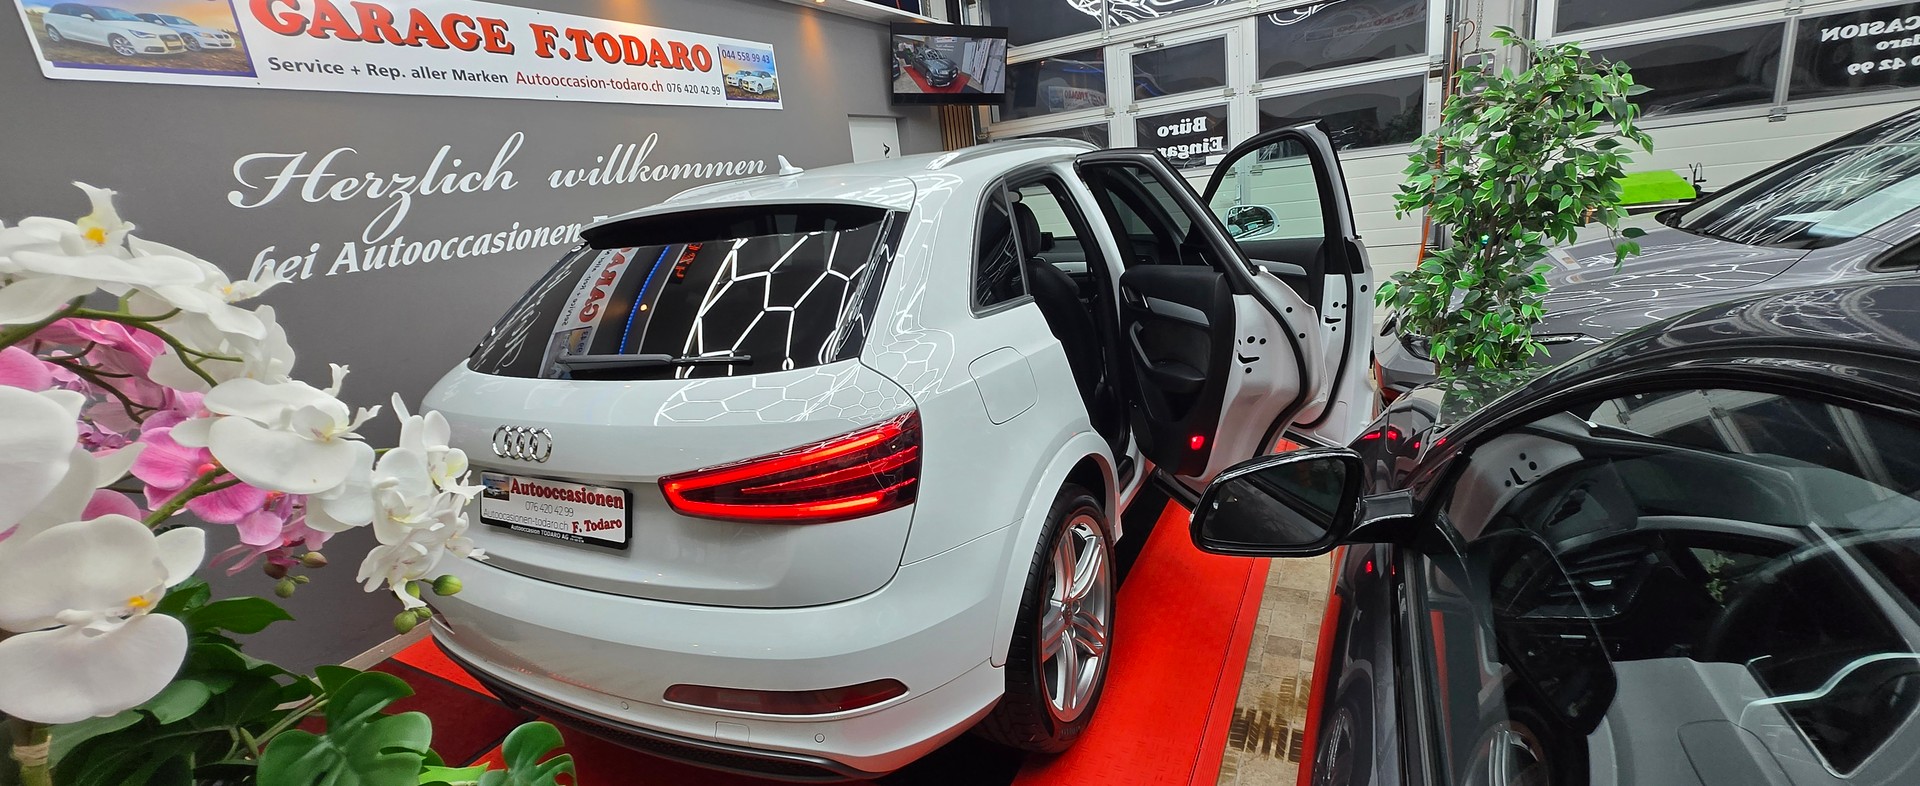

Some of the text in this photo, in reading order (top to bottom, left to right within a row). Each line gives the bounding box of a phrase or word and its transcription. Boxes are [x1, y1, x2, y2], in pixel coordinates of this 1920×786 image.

[249, 0, 713, 73] GARAGE F.TODARO
[721, 49, 771, 64] 044 558 99 43
[267, 57, 344, 75] Service
[366, 63, 406, 81] Rep.
[411, 66, 447, 81] aller
[452, 68, 509, 84] Marken
[516, 71, 663, 93] Autooccasion-todaro.ch
[666, 82, 682, 94] 076
[684, 84, 699, 95] 420
[701, 85, 710, 95] 42
[711, 86, 721, 96] 99
[227, 131, 767, 245] Herzlich willkommen
[247, 221, 582, 283] bei Autooccasionen
[511, 478, 625, 510] Autooccasionen
[525, 501, 574, 518] 076 420 42 99
[541, 529, 561, 540] TODARO
[561, 533, 569, 541] AG
[572, 518, 623, 534] F. Todaro
